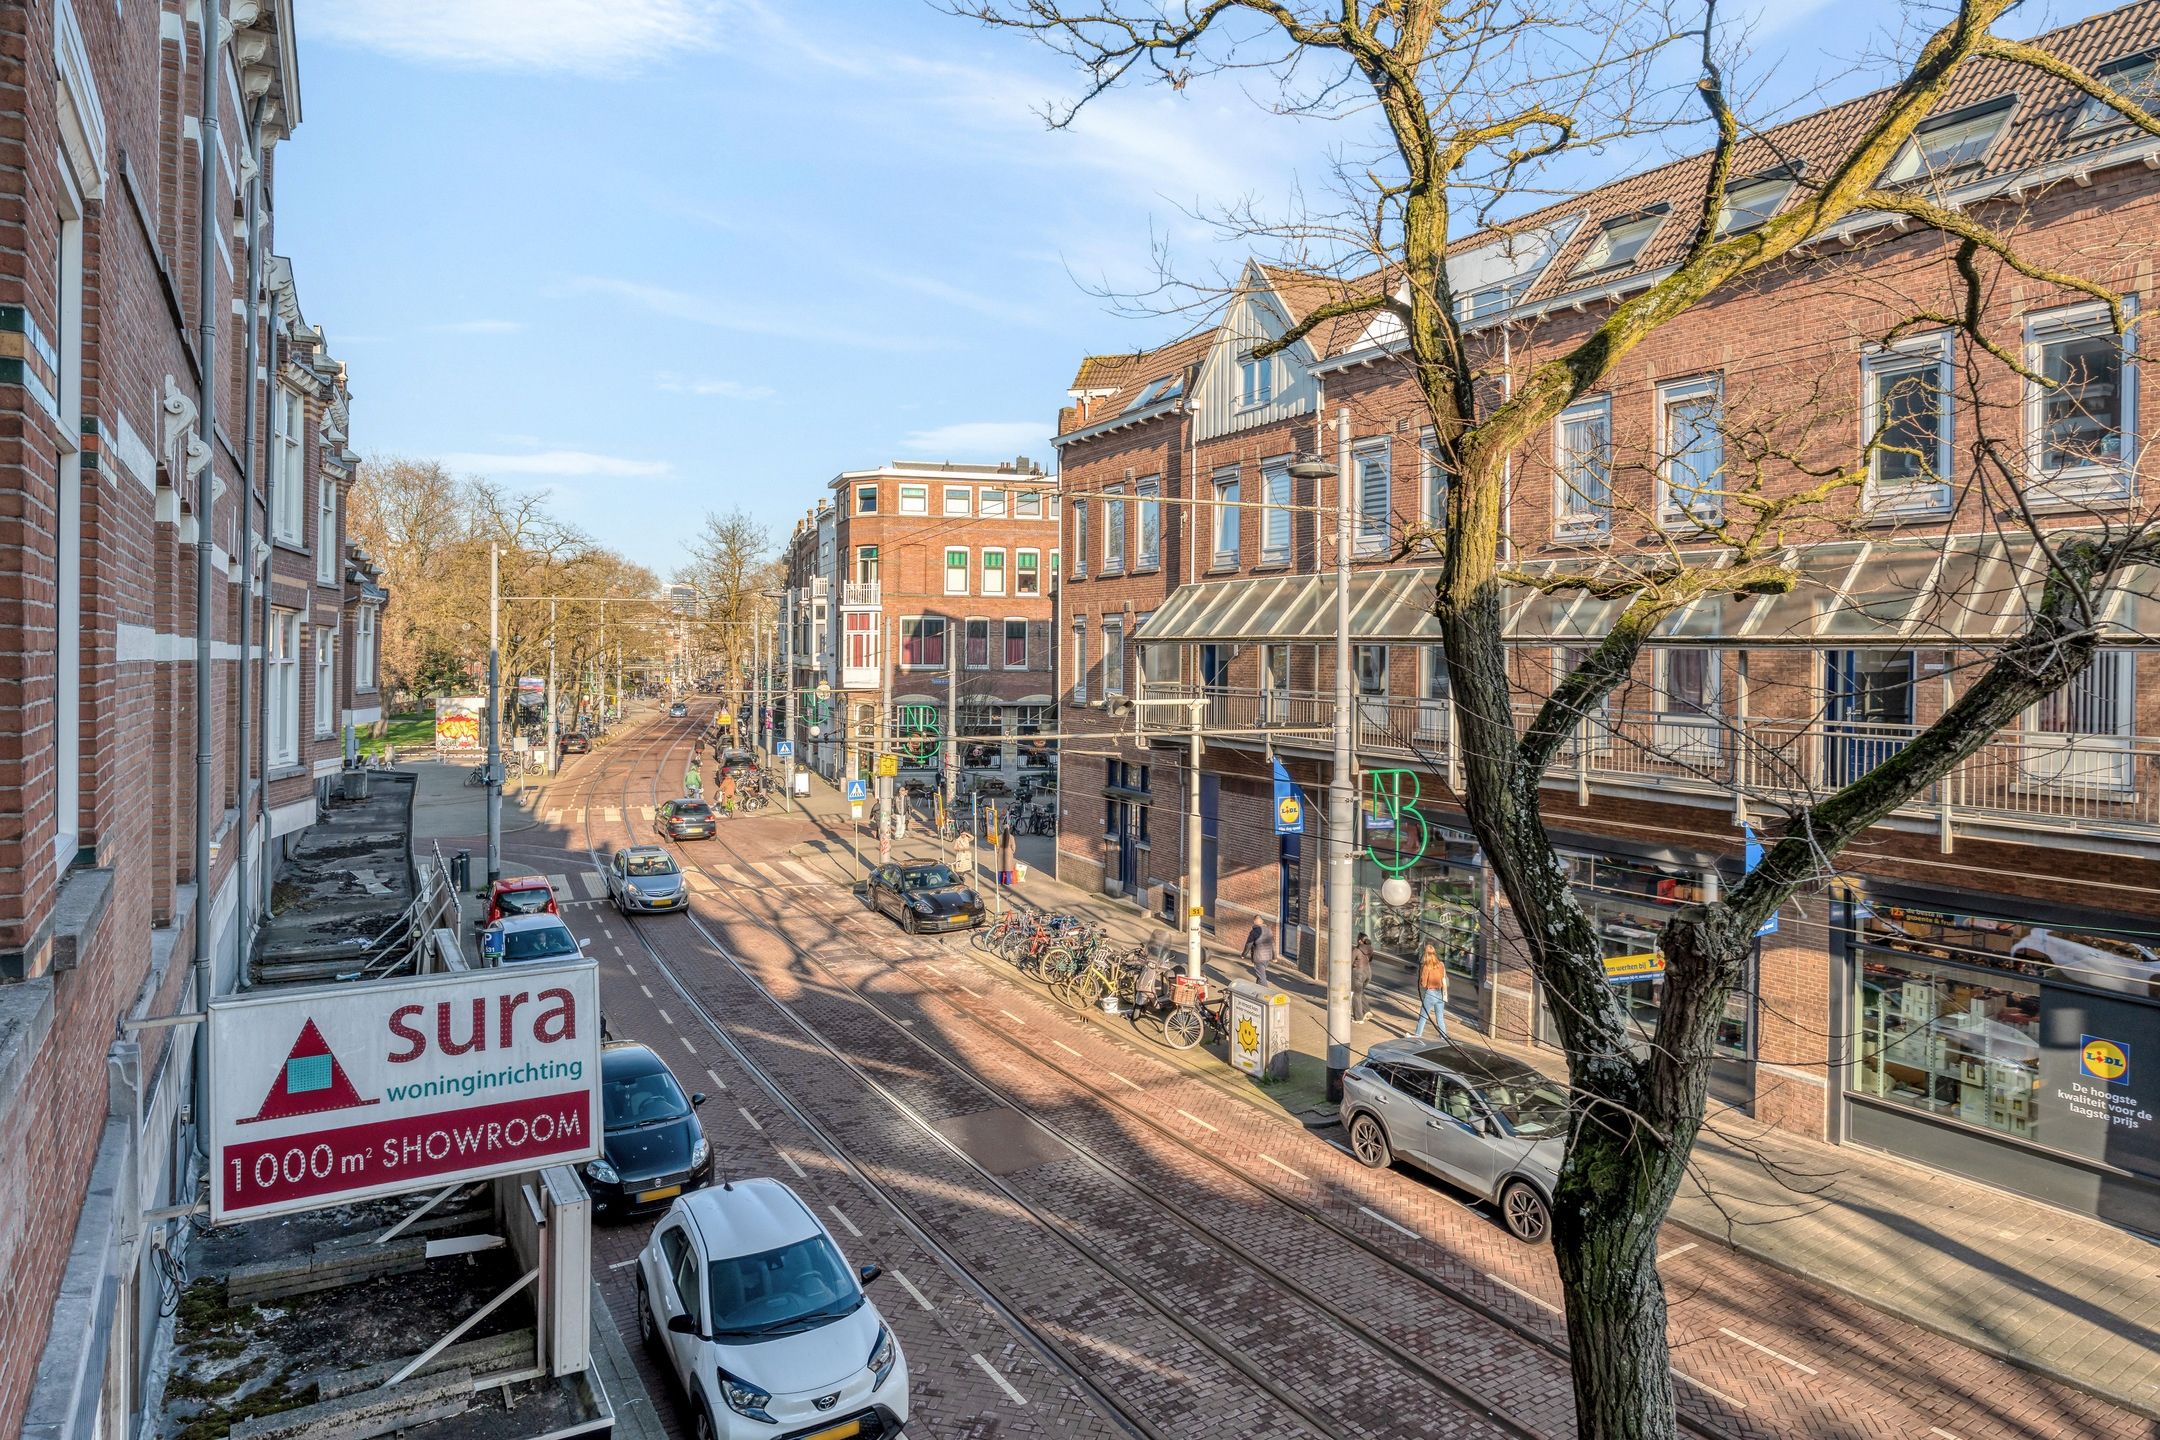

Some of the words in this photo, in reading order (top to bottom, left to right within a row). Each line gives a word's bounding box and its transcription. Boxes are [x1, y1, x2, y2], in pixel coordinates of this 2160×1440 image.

[484, 933, 492, 945] P
[386, 987, 577, 1064] sura
[386, 1060, 584, 1102] woninginrichting
[2072, 1082, 2088, 1094] De
[2090, 1087, 2137, 1106] hoogste
[2057, 1089, 2107, 1109] kwaliteit
[2108, 1103, 2136, 1116] voor
[2137, 1110, 2153, 1121] de
[2069, 1102, 2111, 1121] laagste
[2112, 1115, 2139, 1129] prijs
[383, 1108, 582, 1168] SHOWROOM
